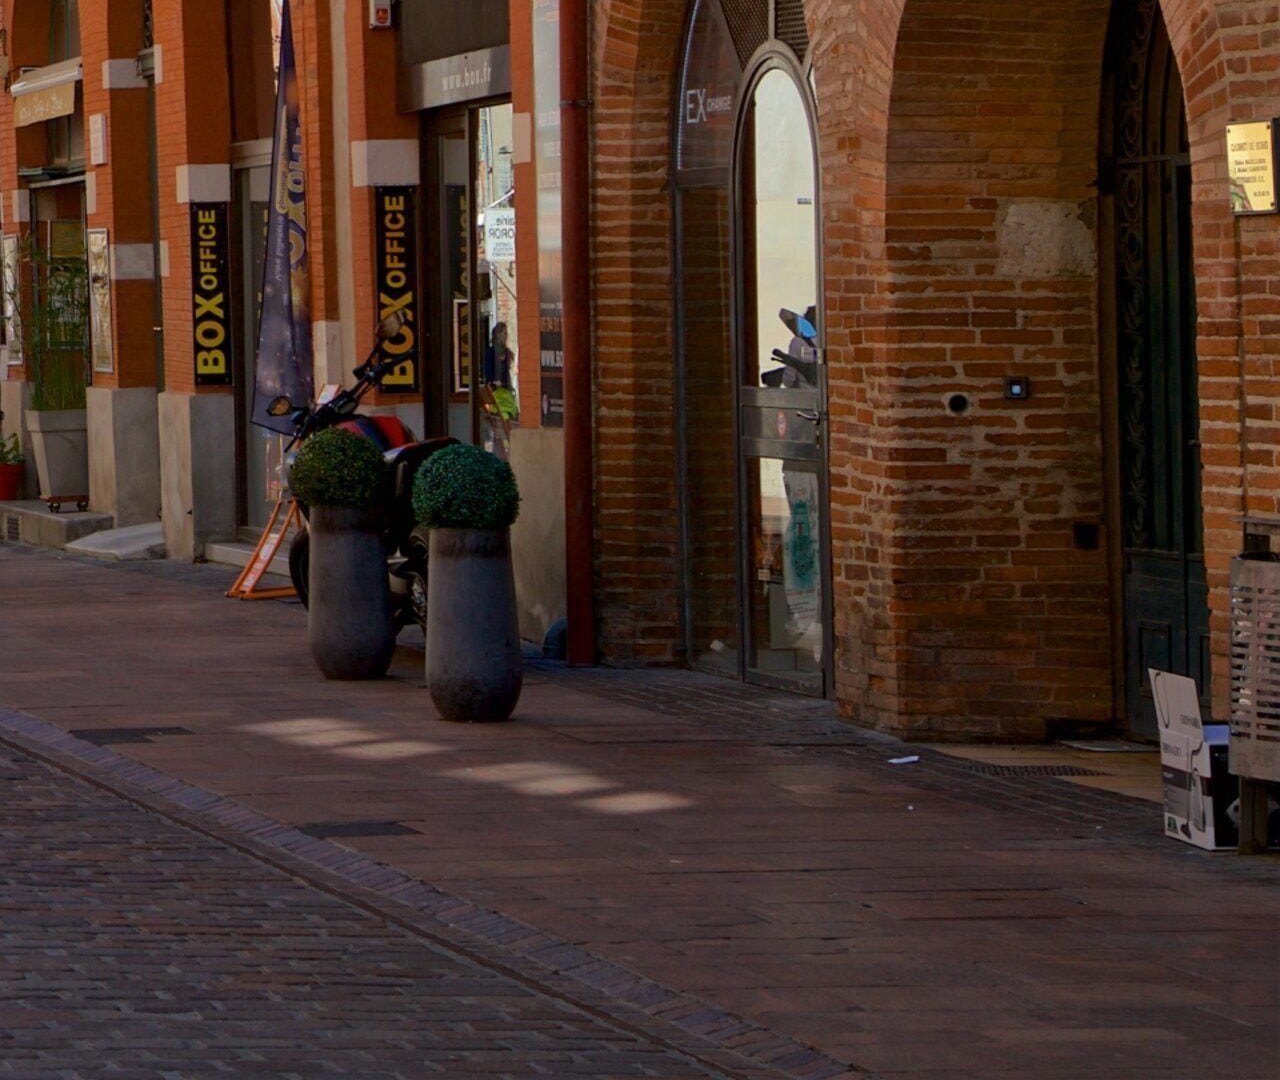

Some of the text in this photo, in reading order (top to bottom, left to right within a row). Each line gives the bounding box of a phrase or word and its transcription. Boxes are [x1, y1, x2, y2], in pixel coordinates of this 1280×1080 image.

[195, 209, 226, 375] BOX OFFICE
[384, 196, 407, 289] OFFICE
